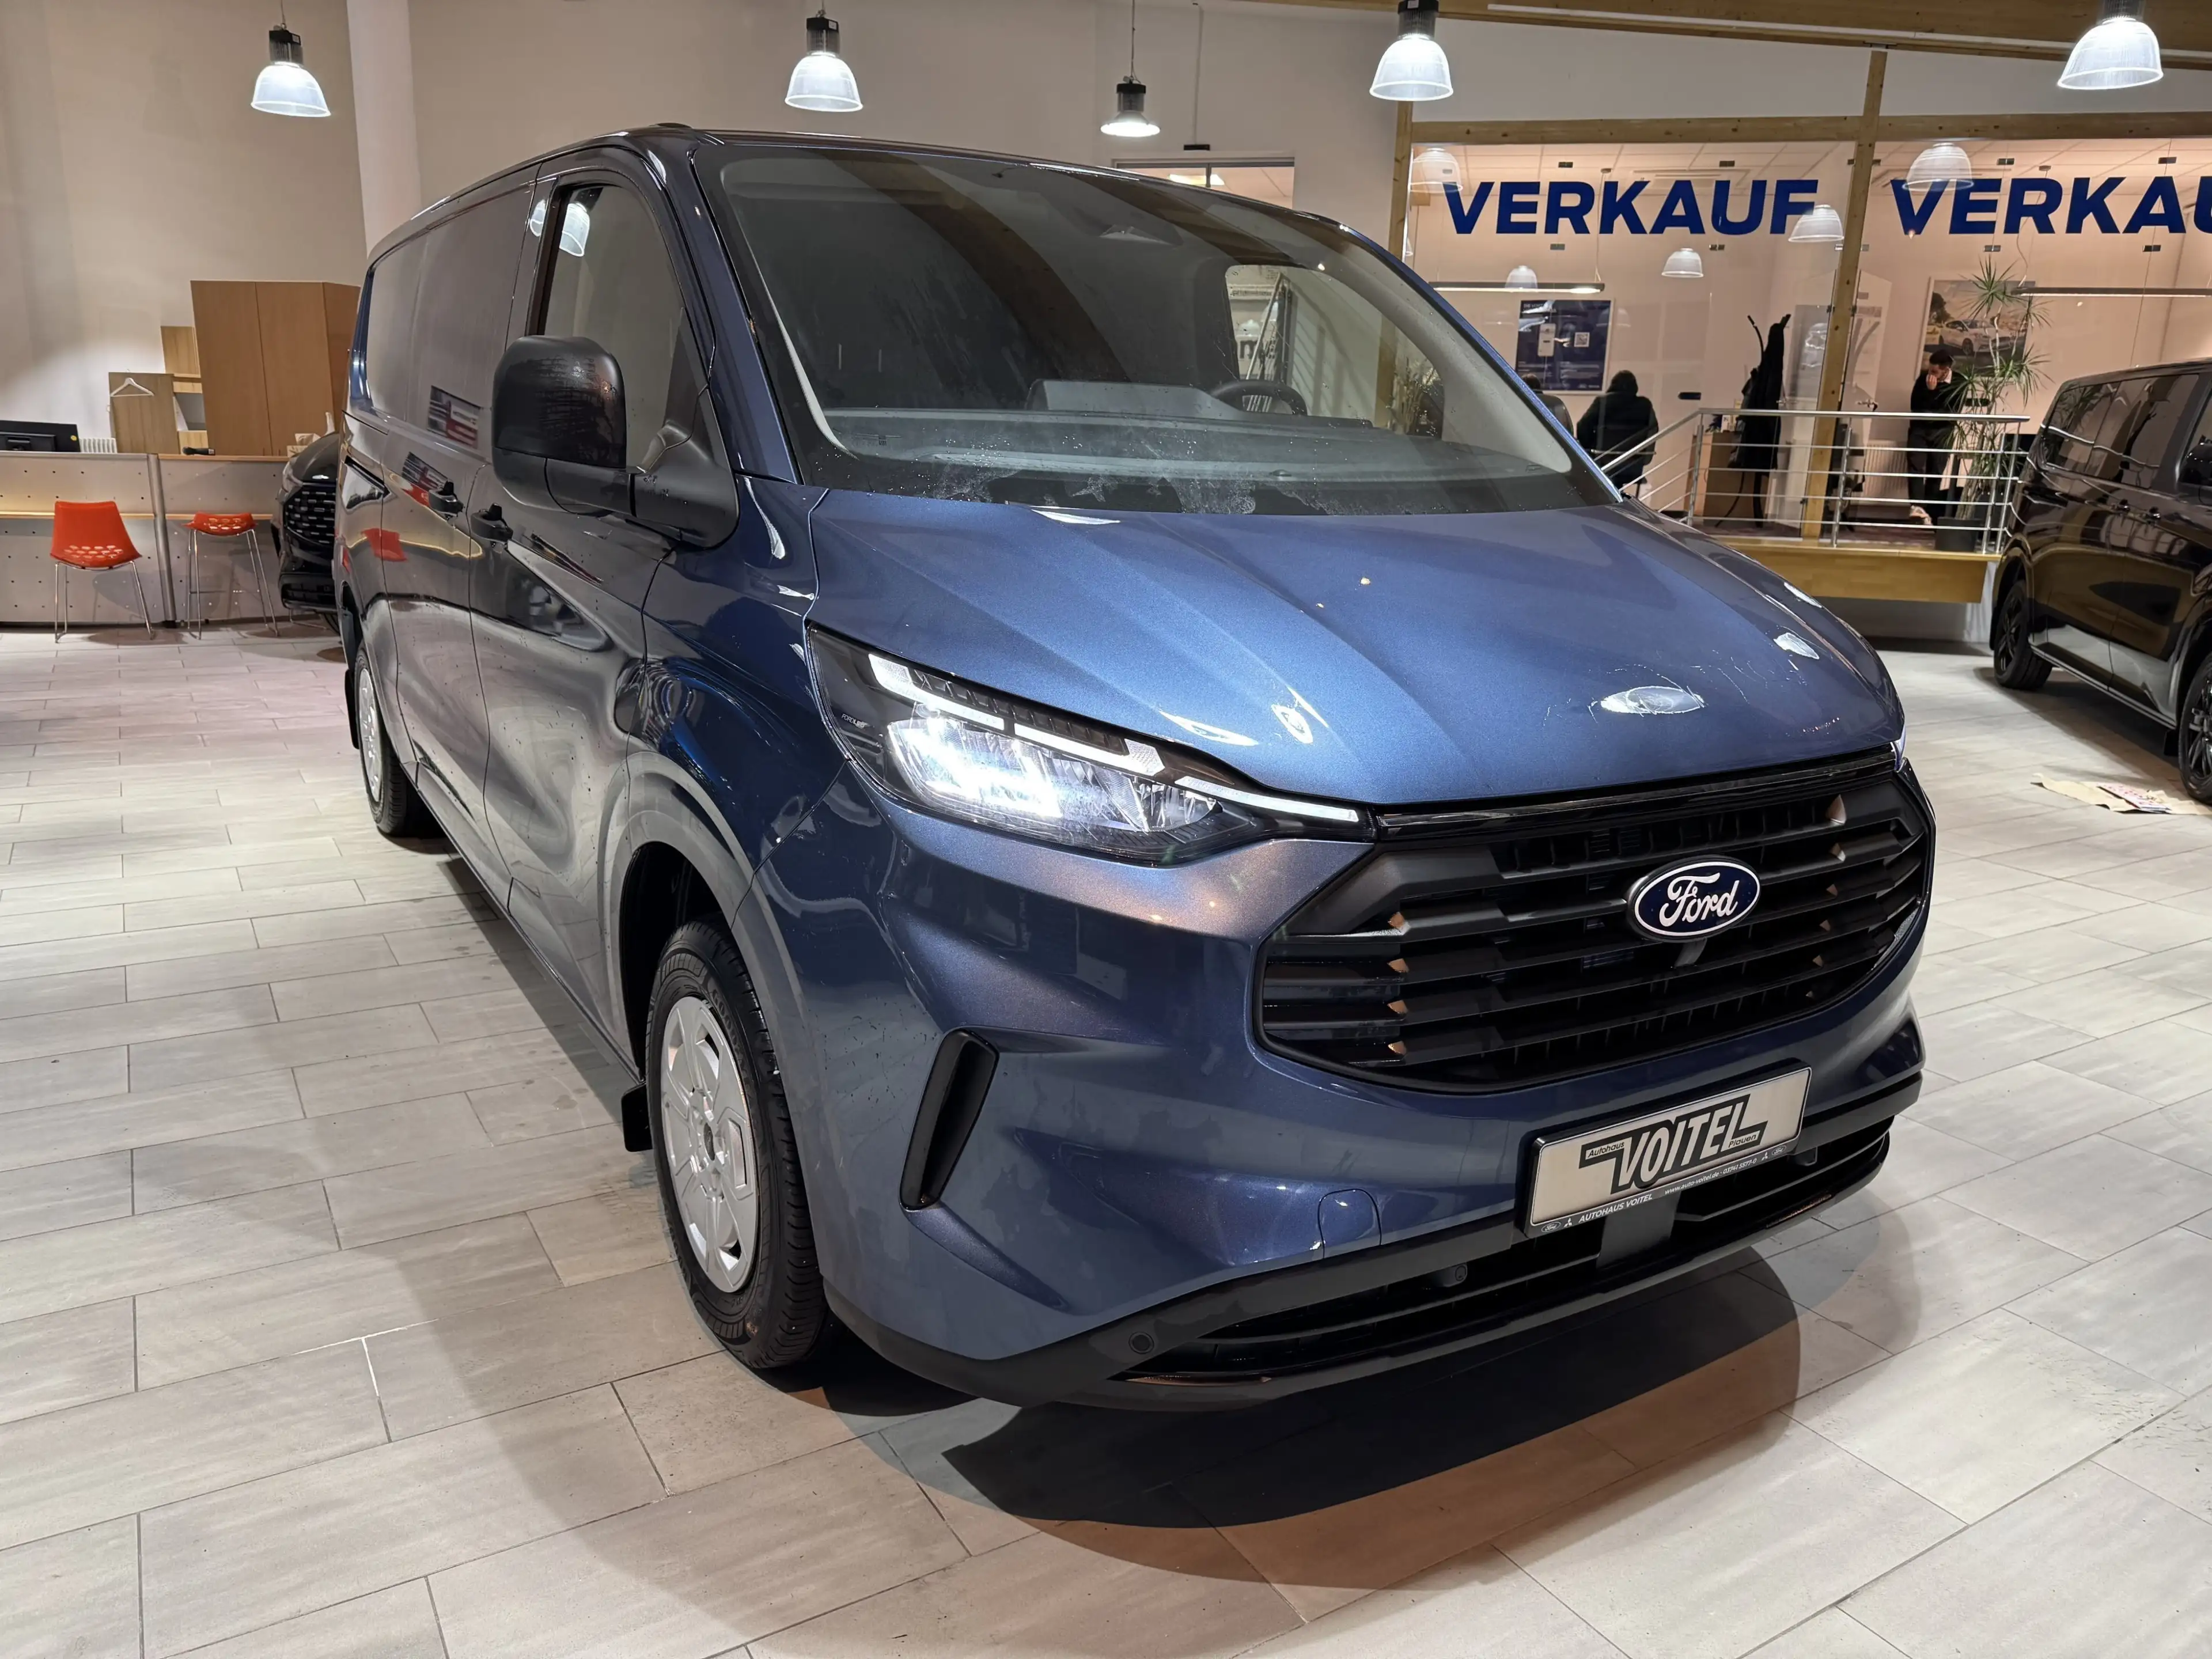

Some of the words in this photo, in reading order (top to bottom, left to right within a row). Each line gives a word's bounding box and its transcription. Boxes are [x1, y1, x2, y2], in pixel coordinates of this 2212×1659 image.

[1442, 179, 1819, 236] VERKAUF
[1657, 870, 1741, 929] Ford
[1588, 1141, 1625, 1158] Autohaus
[1615, 1099, 1751, 1189] VOITEL
[1728, 1134, 1756, 1148] Plauen
[1578, 1202, 1624, 1224] AUTOHAUS
[1626, 1193, 1653, 1208] VOITEL
